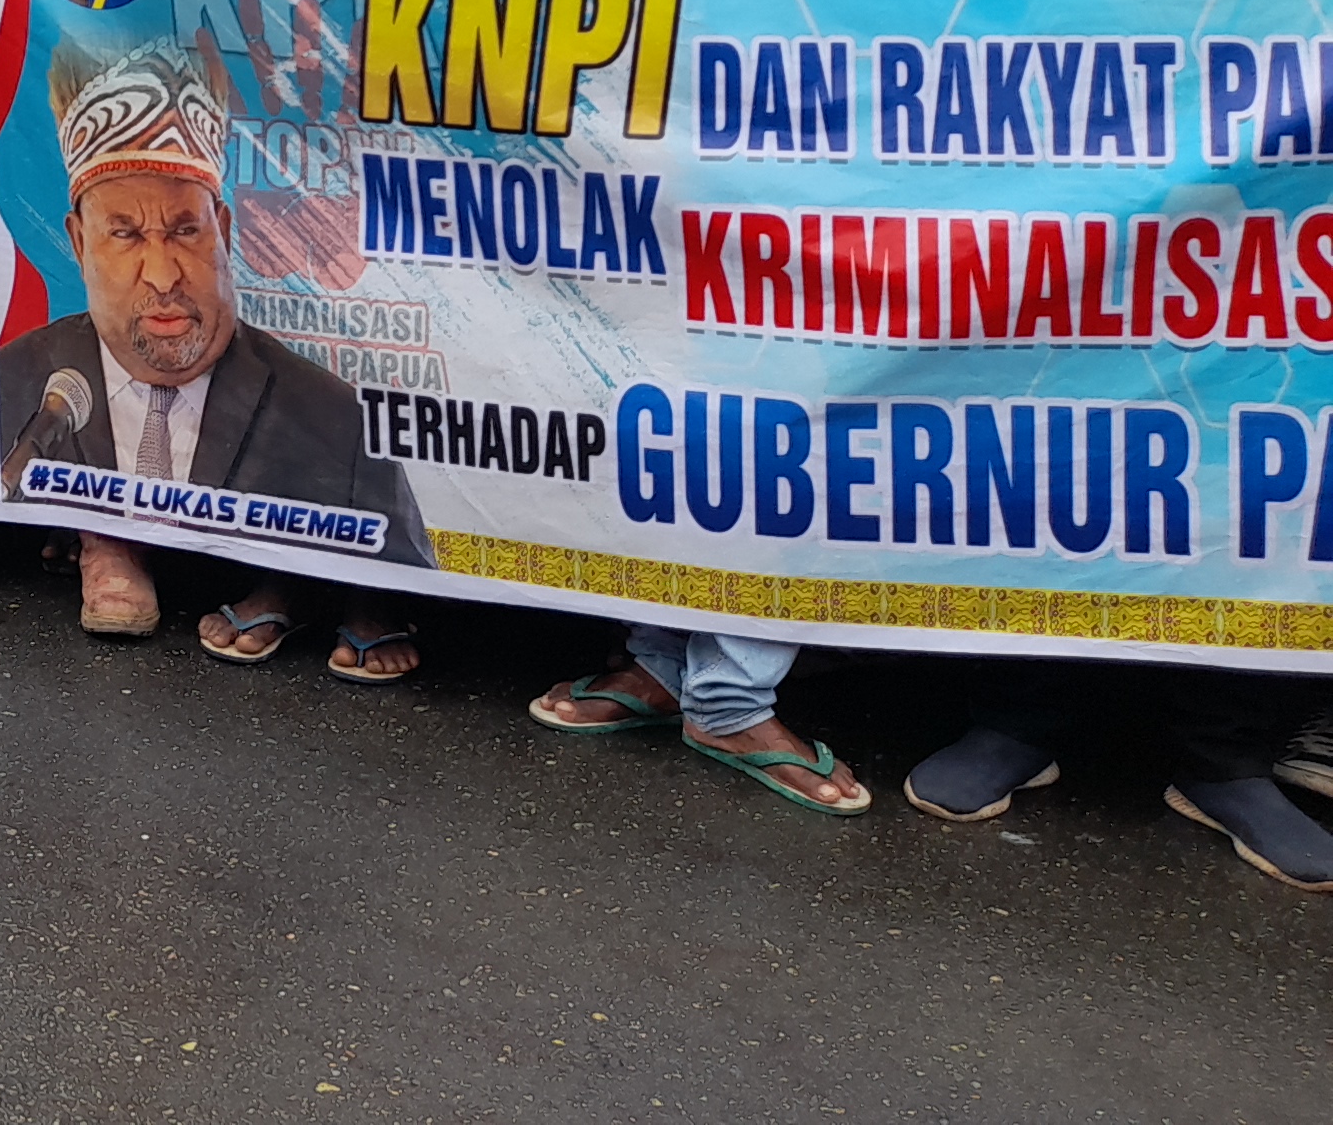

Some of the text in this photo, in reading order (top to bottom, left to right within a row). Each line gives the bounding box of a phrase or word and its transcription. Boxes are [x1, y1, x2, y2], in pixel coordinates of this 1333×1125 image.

[698, 41, 848, 153] DAN
[879, 41, 1176, 159] RAKYAT
[362, 153, 666, 275] MENOLAK
[28, 464, 382, 546] #SAVE LUKAS ENEMBE
[362, 387, 606, 482] TERHADAP
[617, 383, 1191, 556] GUBERNUR
